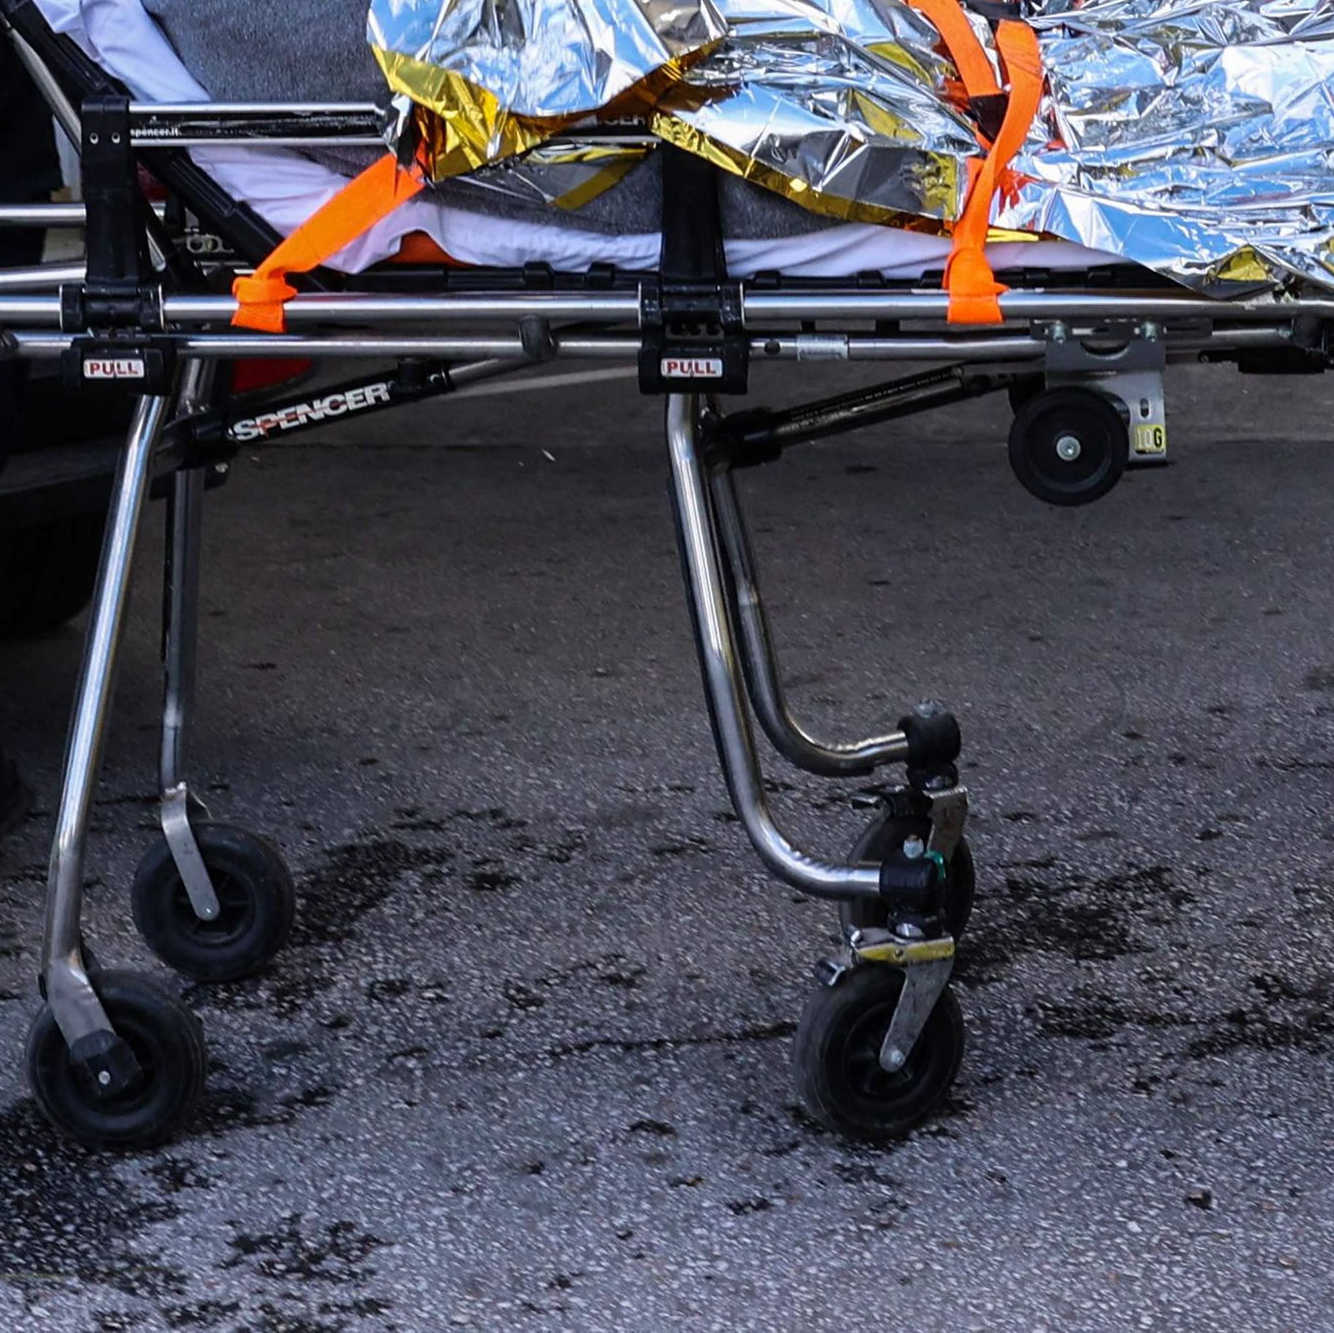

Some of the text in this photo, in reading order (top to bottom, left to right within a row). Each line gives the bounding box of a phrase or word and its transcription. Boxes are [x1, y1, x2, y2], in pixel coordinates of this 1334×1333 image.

[89, 362, 139, 376] PULL
[667, 361, 717, 374] PULL
[232, 383, 391, 442] SPENCER
